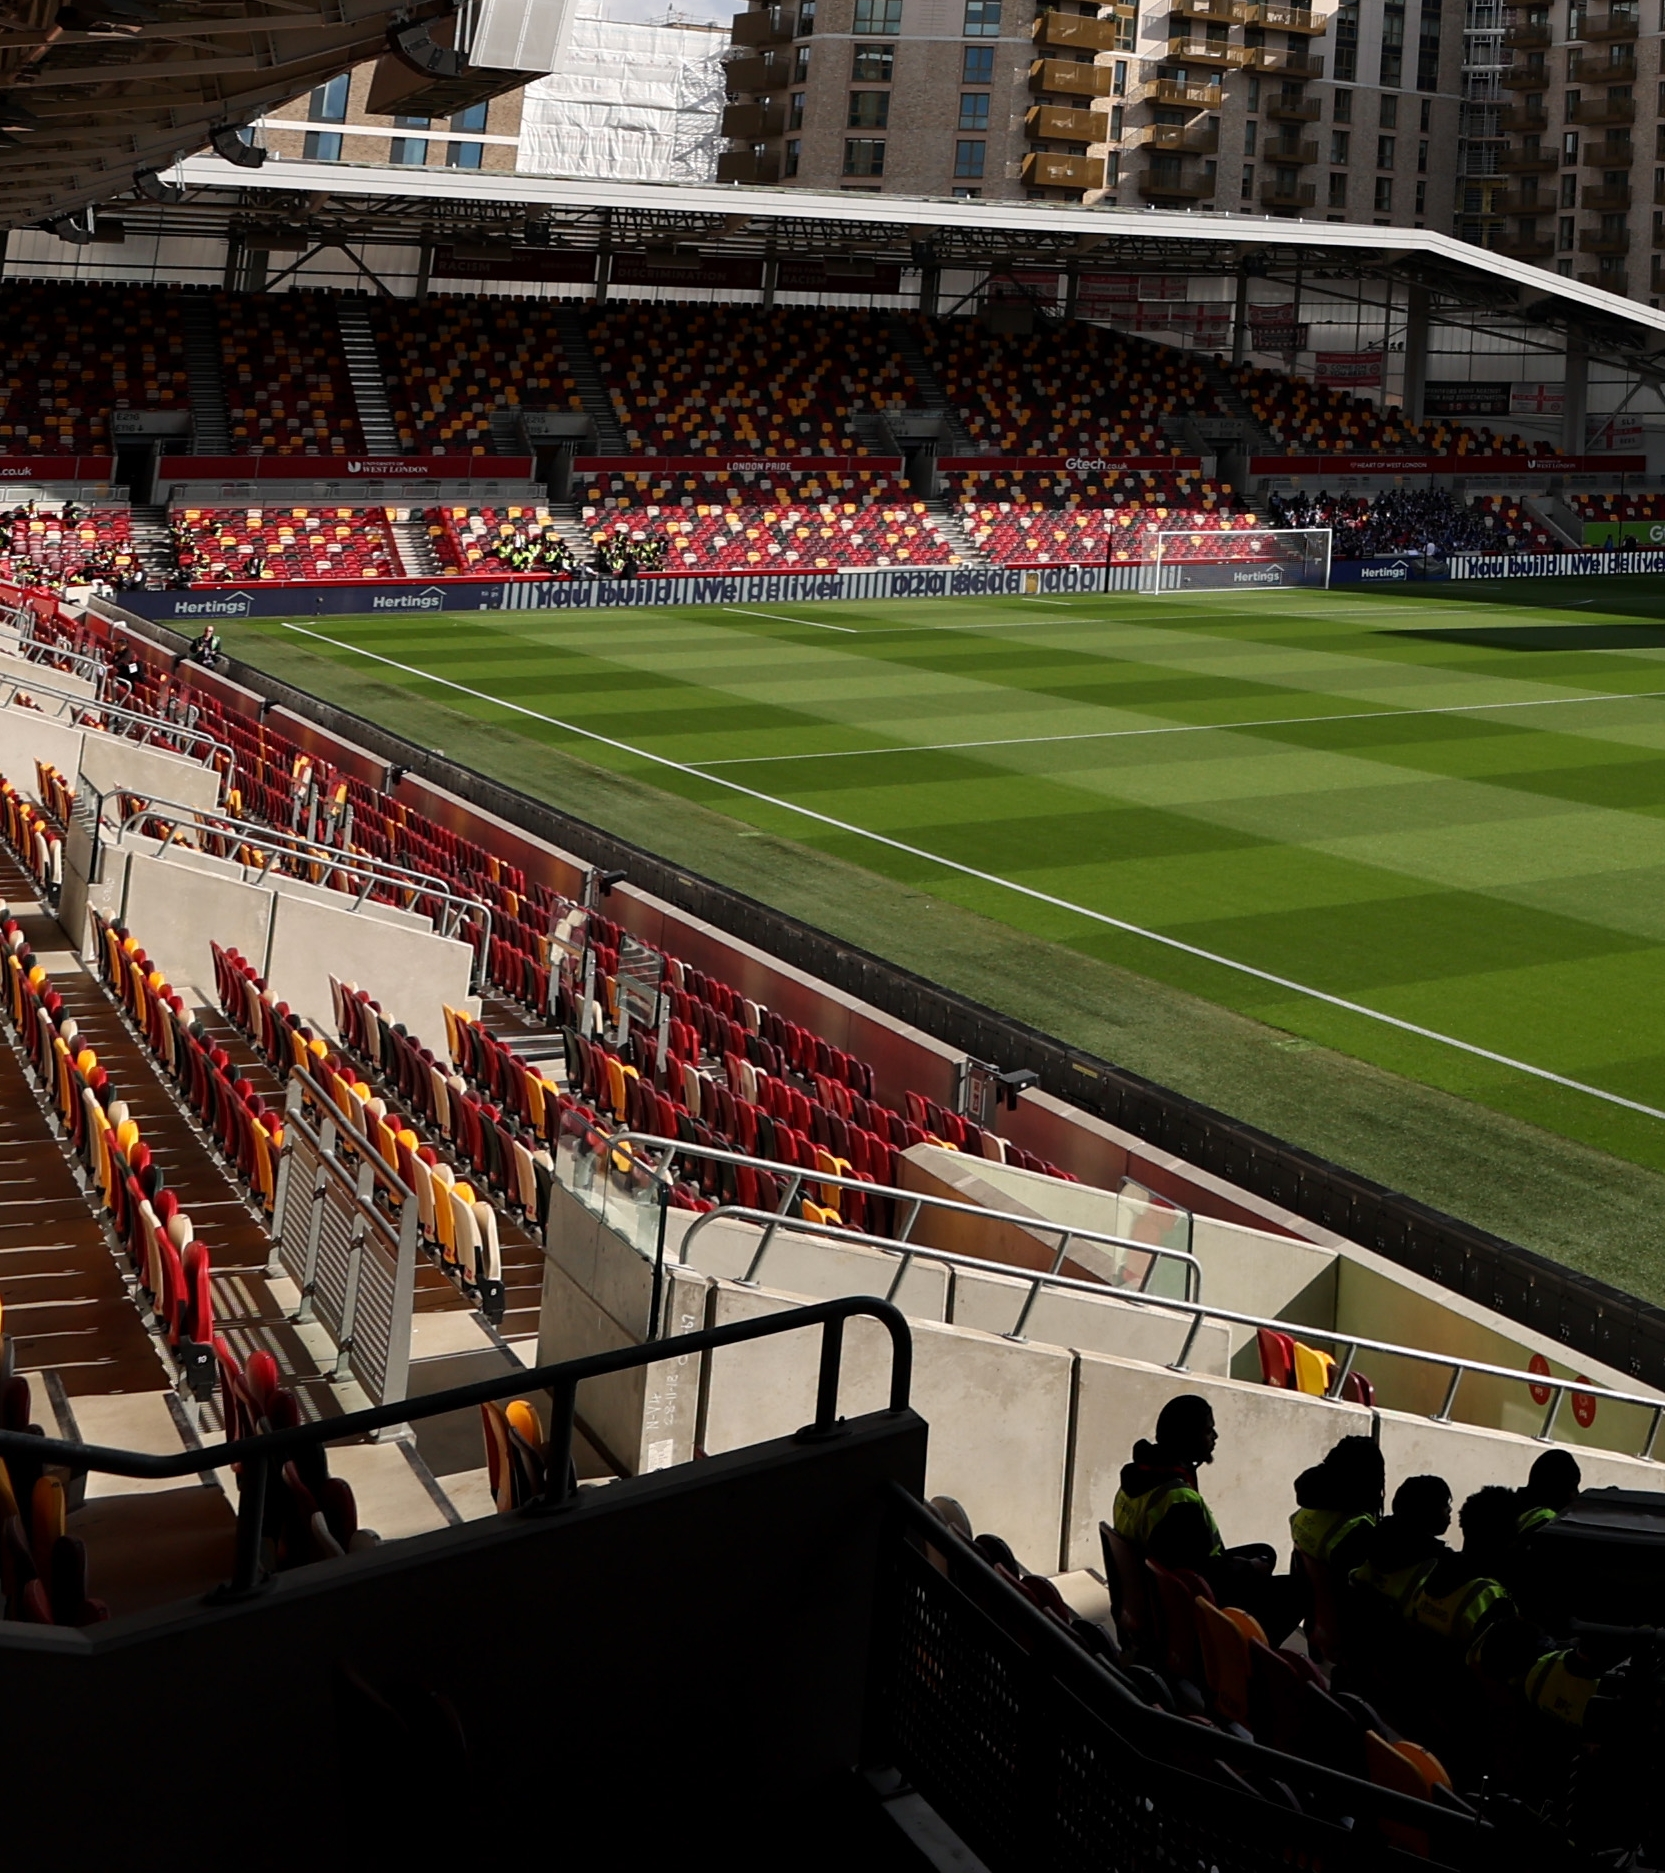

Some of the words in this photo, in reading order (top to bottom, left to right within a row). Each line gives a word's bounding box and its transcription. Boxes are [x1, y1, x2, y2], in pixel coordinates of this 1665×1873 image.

[438, 261, 491, 273] RACISM
[617, 267, 727, 282] DISCRIMINATION
[781, 274, 828, 286] RACISM
[116, 413, 140, 421] E216
[389, 466, 429, 474] LONDON
[726, 462, 764, 471] LONDON
[765, 462, 792, 471] PRIDE
[1065, 457, 1128, 470] Gtech.co.uk
[1467, 556, 1503, 577] You
[1572, 553, 1601, 573] We
[1233, 571, 1280, 584] Hertings
[1361, 567, 1405, 579] Hertings
[536, 584, 591, 609] You
[695, 579, 738, 603] We
[749, 578, 844, 602] deliver
[892, 574, 943, 596] 020
[951, 571, 1021, 594] 8606
[1028, 569, 1096, 593] 000
[174, 600, 247, 615] Hertings
[373, 594, 440, 610] Hertings
